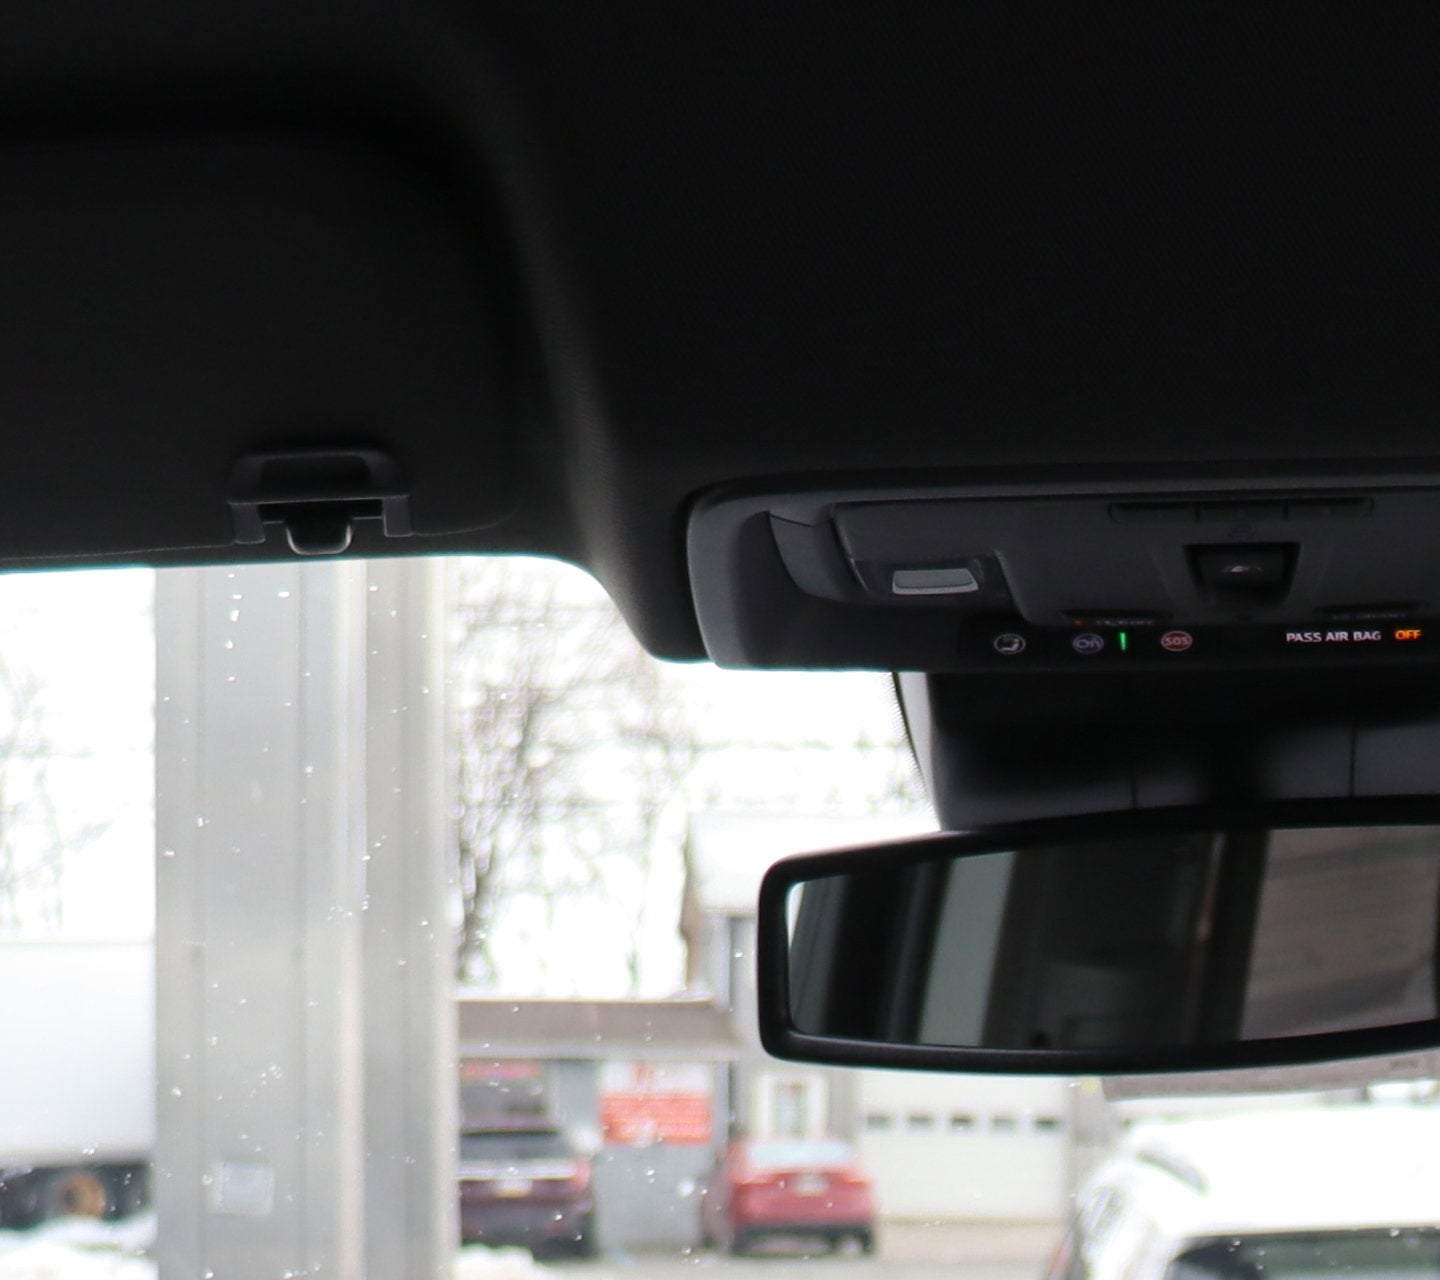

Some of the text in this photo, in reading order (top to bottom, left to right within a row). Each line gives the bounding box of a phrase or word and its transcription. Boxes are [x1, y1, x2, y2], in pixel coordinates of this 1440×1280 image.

[1162, 636, 1192, 646] SOS
[1285, 629, 1421, 642] PASS AIR BAG OFF
